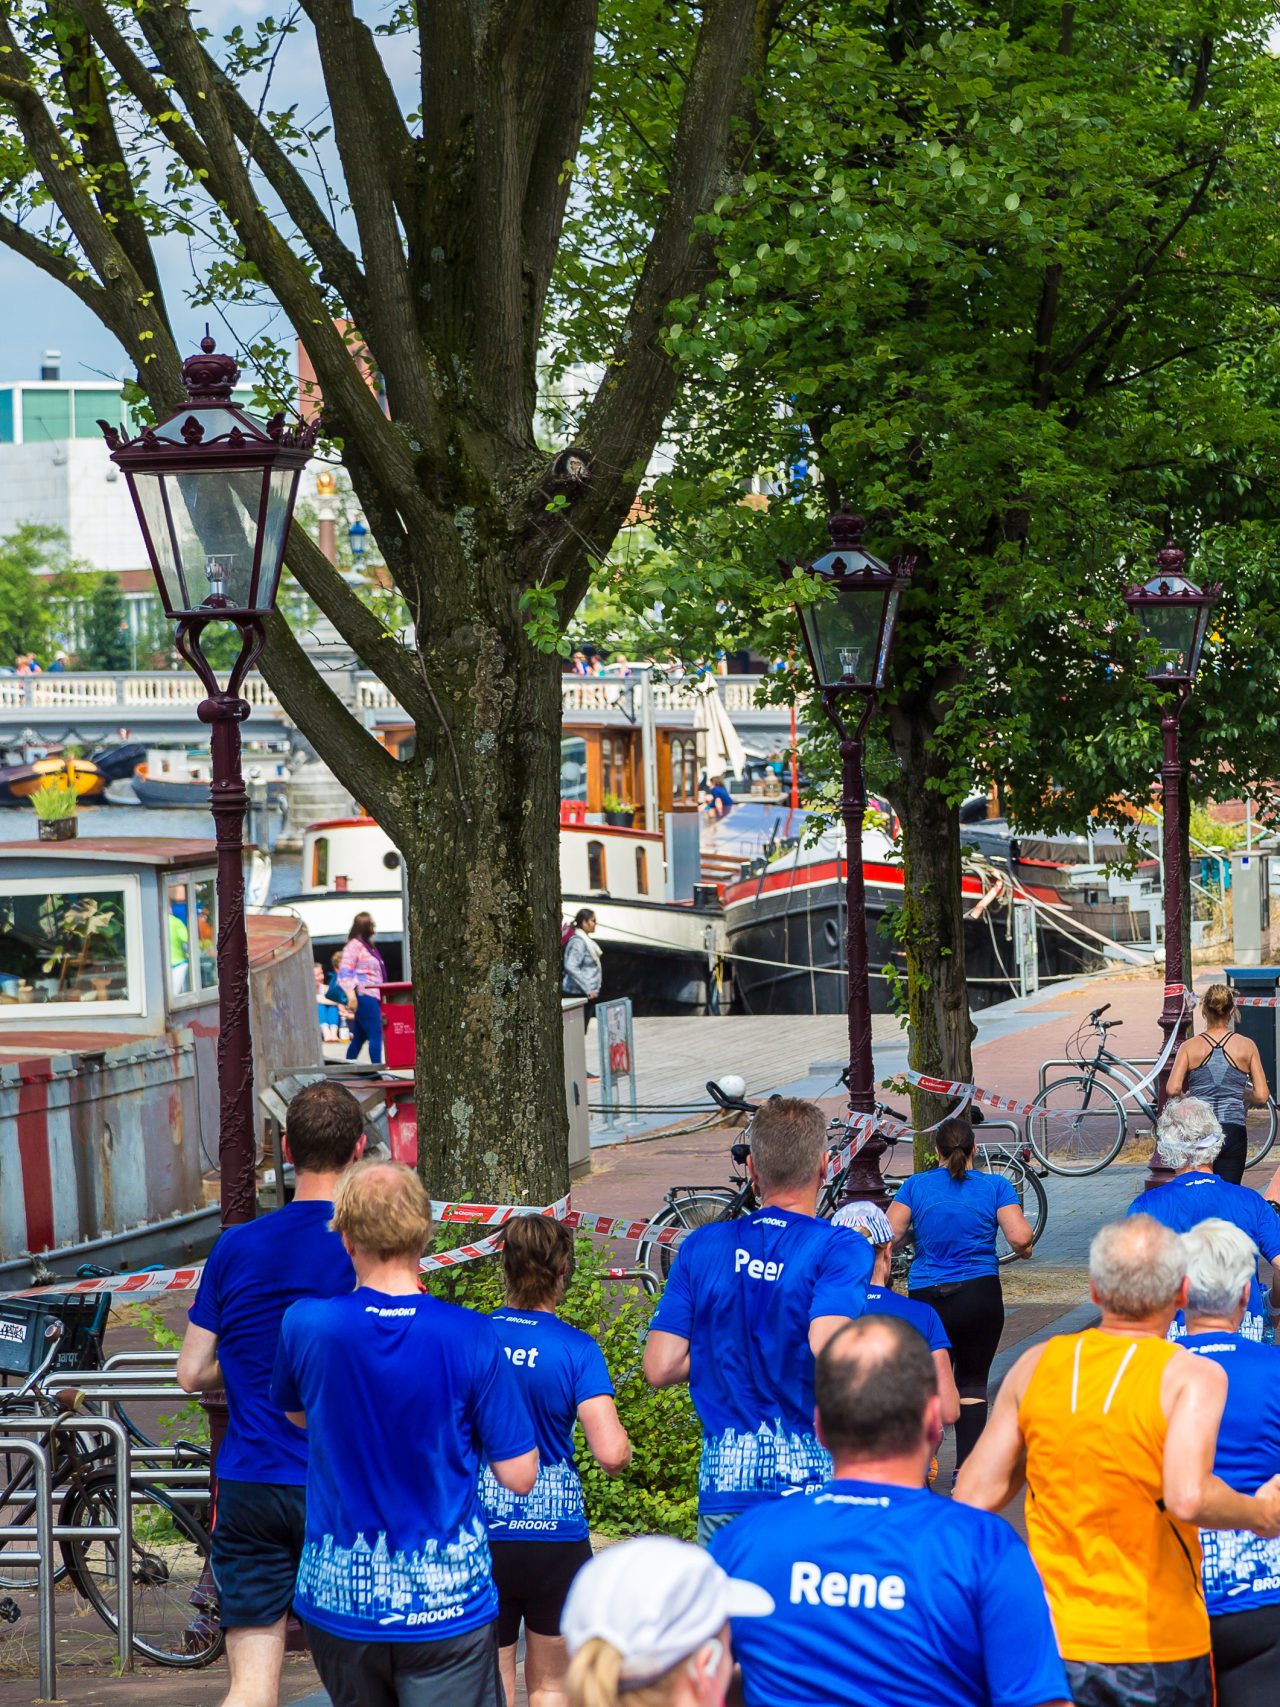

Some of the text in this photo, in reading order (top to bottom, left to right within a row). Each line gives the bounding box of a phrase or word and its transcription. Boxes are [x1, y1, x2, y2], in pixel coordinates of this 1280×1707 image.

[378, 1307, 417, 1317] BROOKS
[505, 1316, 539, 1326] BROOKS
[508, 1519, 558, 1531] BROOKS
[790, 1561, 906, 1611] Rene
[406, 1604, 465, 1626] BROOKS
